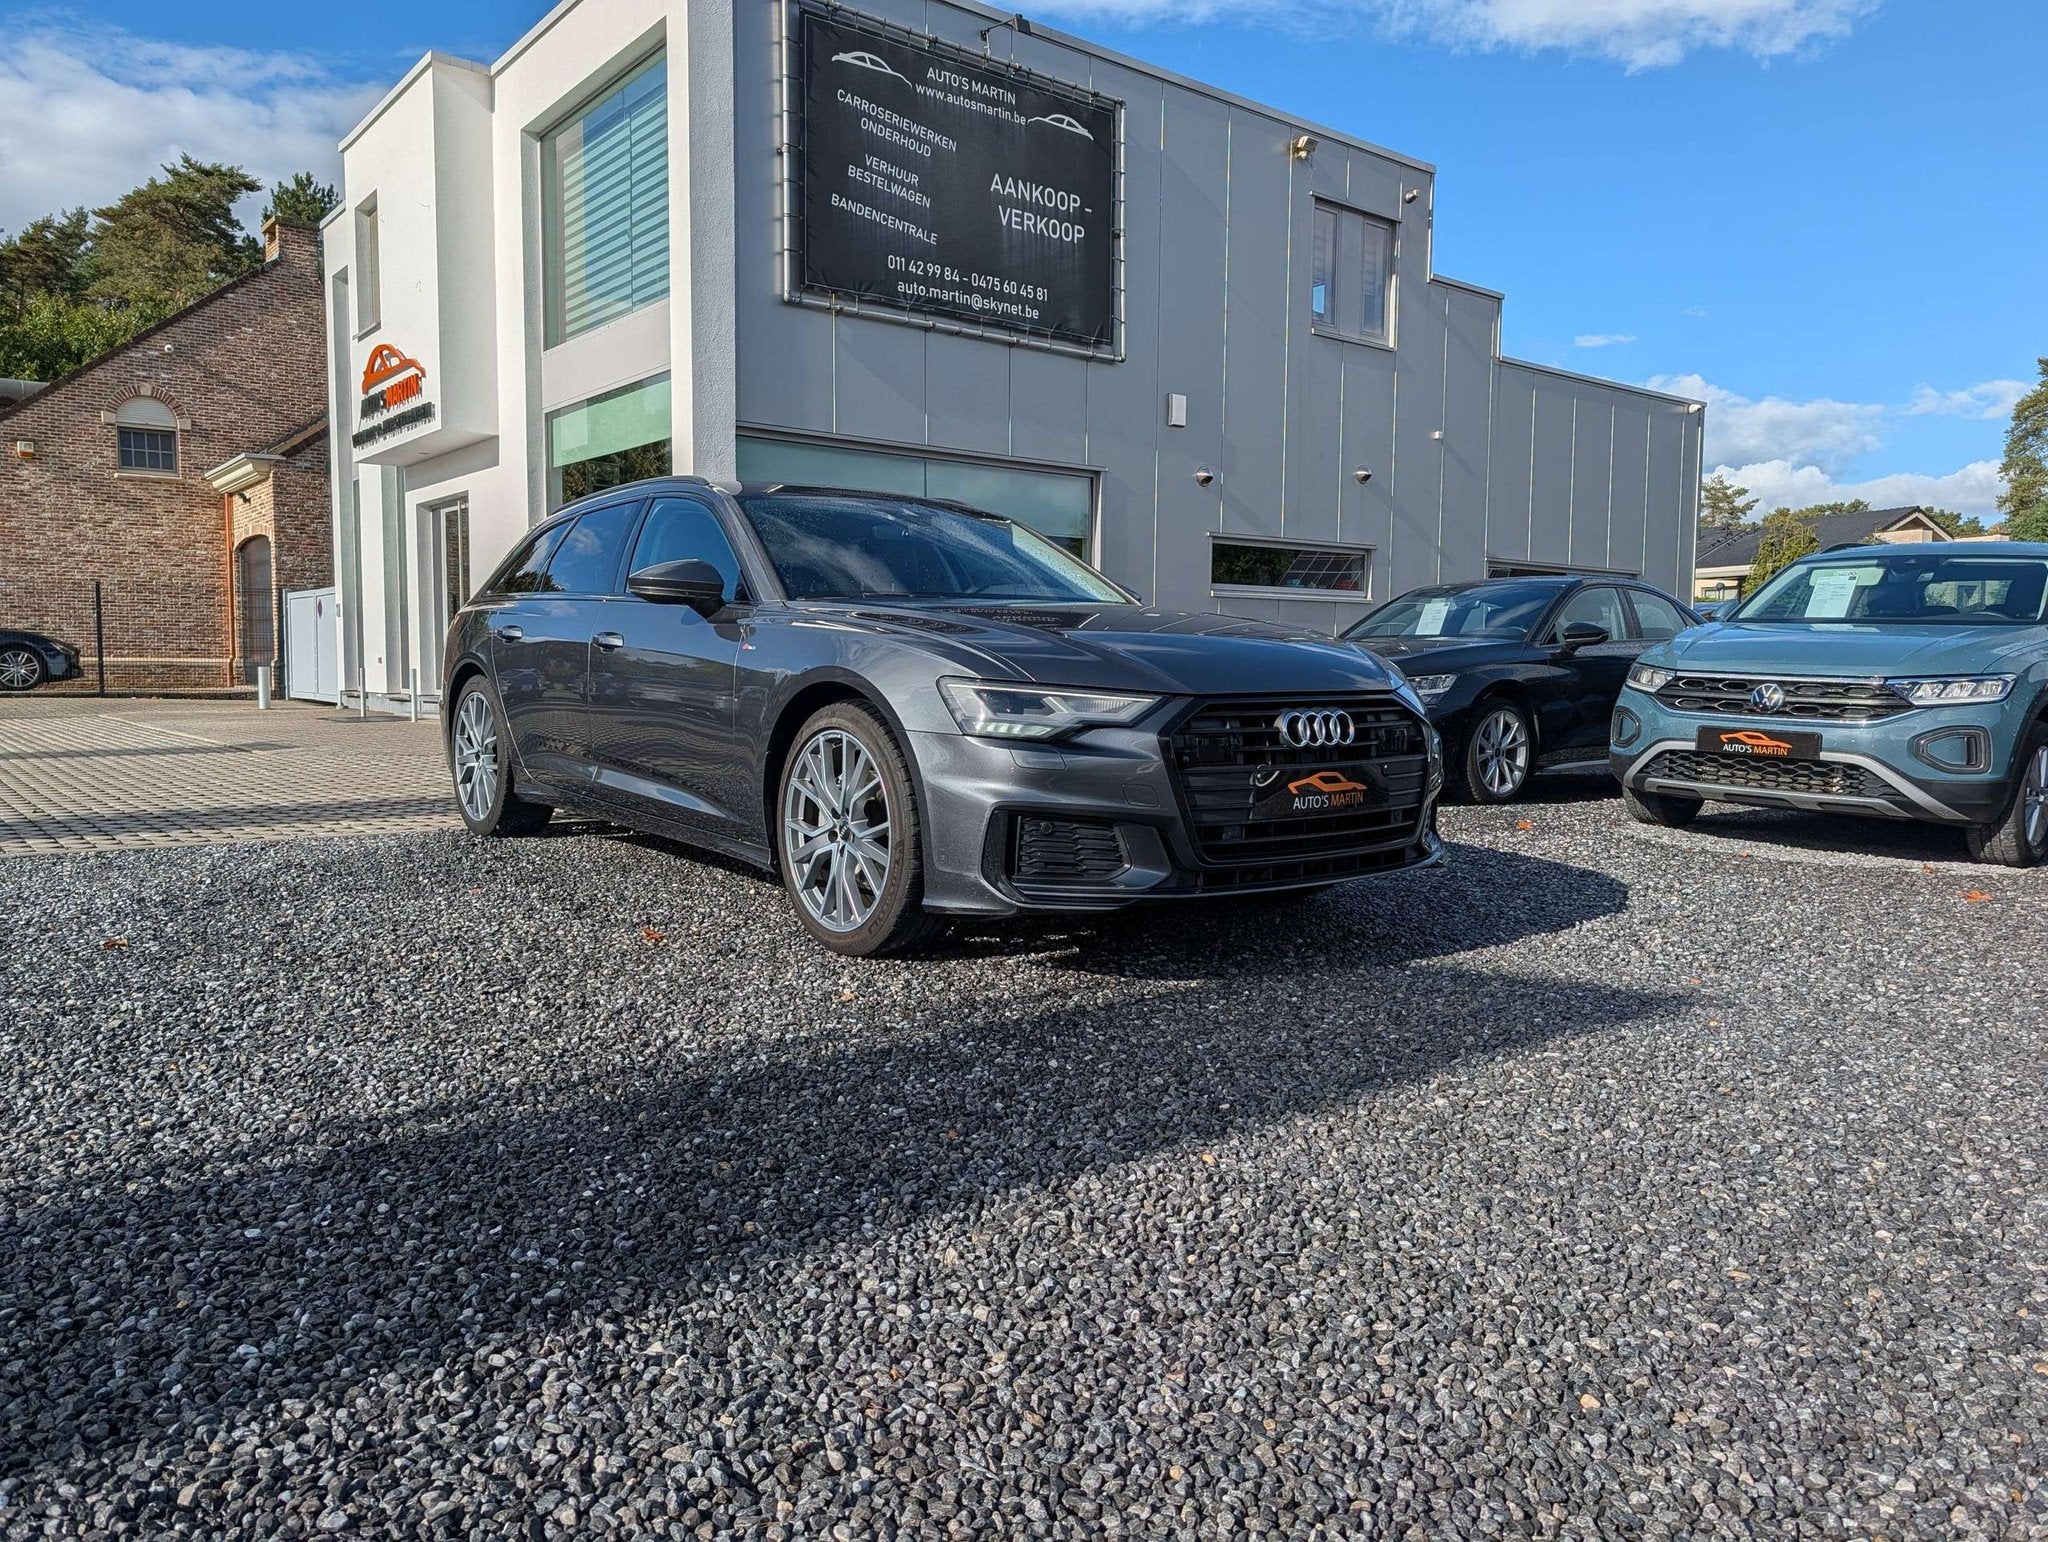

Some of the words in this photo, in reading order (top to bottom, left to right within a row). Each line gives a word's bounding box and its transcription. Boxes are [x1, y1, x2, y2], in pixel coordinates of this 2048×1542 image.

[915, 83, 1026, 126] www.autosmartin.be
[926, 66, 970, 90] AUTO'S
[971, 79, 1016, 106] MARTIN
[836, 88, 957, 153] CARROSERIEWERKEN
[860, 117, 932, 158] ONDERHOUD
[847, 164, 931, 209] BESTELWAGEN
[864, 153, 919, 187] VERHUUR
[831, 192, 938, 246] BANDENCENTRALE
[998, 204, 1085, 244] VERKOOP
[887, 254, 906, 272] 011
[908, 260, 924, 276] 42
[926, 265, 942, 279] 99
[943, 268, 960, 284] 84
[971, 273, 1001, 292] 0475
[1003, 280, 1017, 294] 60
[1019, 284, 1034, 299] 45
[1036, 287, 1048, 302] 81
[897, 280, 1039, 320] auto.martin@skynet.be
[1722, 744, 1752, 754] AUTO'S
[1753, 747, 1787, 756] MARTIN
[1293, 795, 1329, 809] AUTO'S
[1330, 792, 1364, 807] MARTIN
